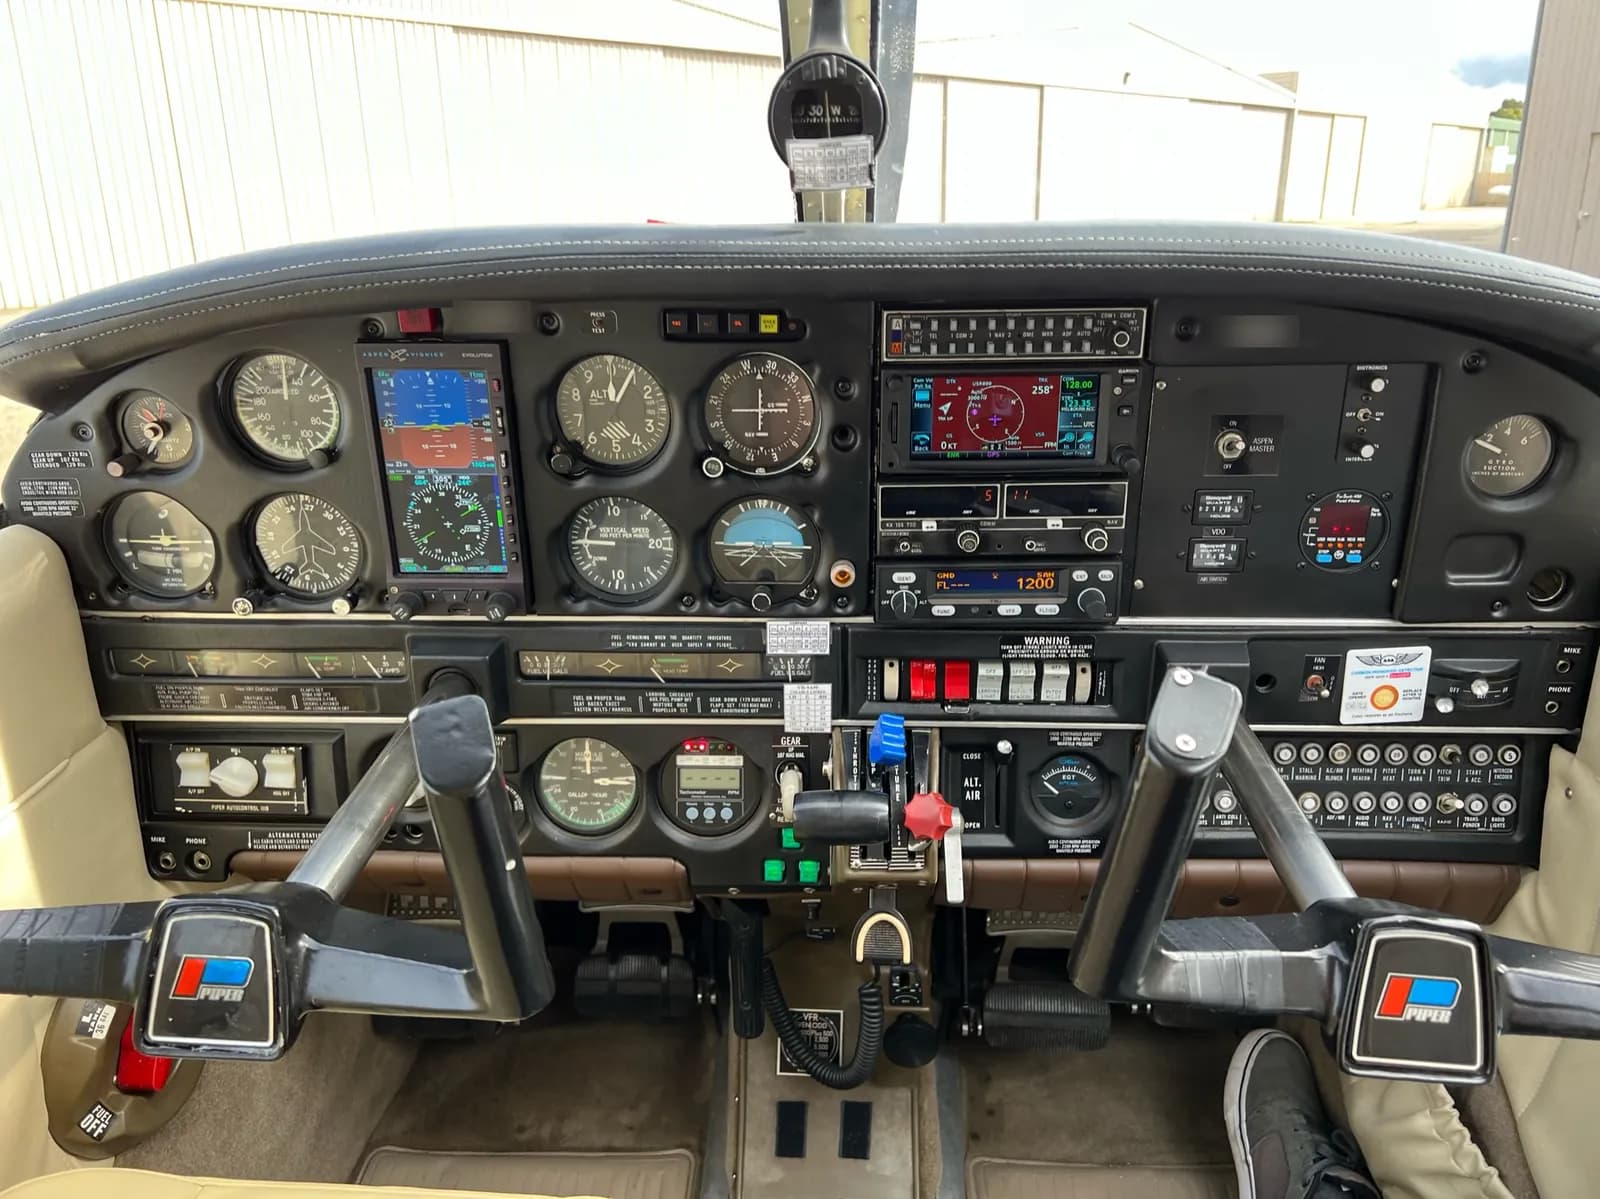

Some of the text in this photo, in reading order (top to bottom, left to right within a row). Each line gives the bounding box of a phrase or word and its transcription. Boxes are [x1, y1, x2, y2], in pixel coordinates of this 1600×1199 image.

[808, 106, 841, 116] 30 W
[741, 360, 750, 369] W
[766, 360, 776, 369] 30
[584, 371, 592, 382] 9
[572, 388, 580, 400] 8
[644, 386, 652, 399] 2
[574, 414, 582, 426] 7
[645, 420, 654, 432] 3
[588, 432, 598, 444] 6
[632, 434, 642, 445] 4
[1521, 437, 1527, 445] 6
[612, 441, 621, 452] 5
[323, 511, 333, 520] 30
[608, 506, 620, 517] 10
[648, 539, 662, 549] 20
[612, 570, 624, 580] 10
[1017, 578, 1054, 590] 1200
[1024, 637, 1070, 645] WARNING
[781, 737, 801, 745] GEAR
[964, 777, 982, 787] ALT.
[965, 789, 981, 800] AIR
[199, 987, 244, 1001] PIPER
[803, 1013, 819, 1021] VFR
[1405, 1008, 1453, 1023] PIPER
[92, 1104, 112, 1124] FUEL
[80, 1114, 108, 1138] OFF
